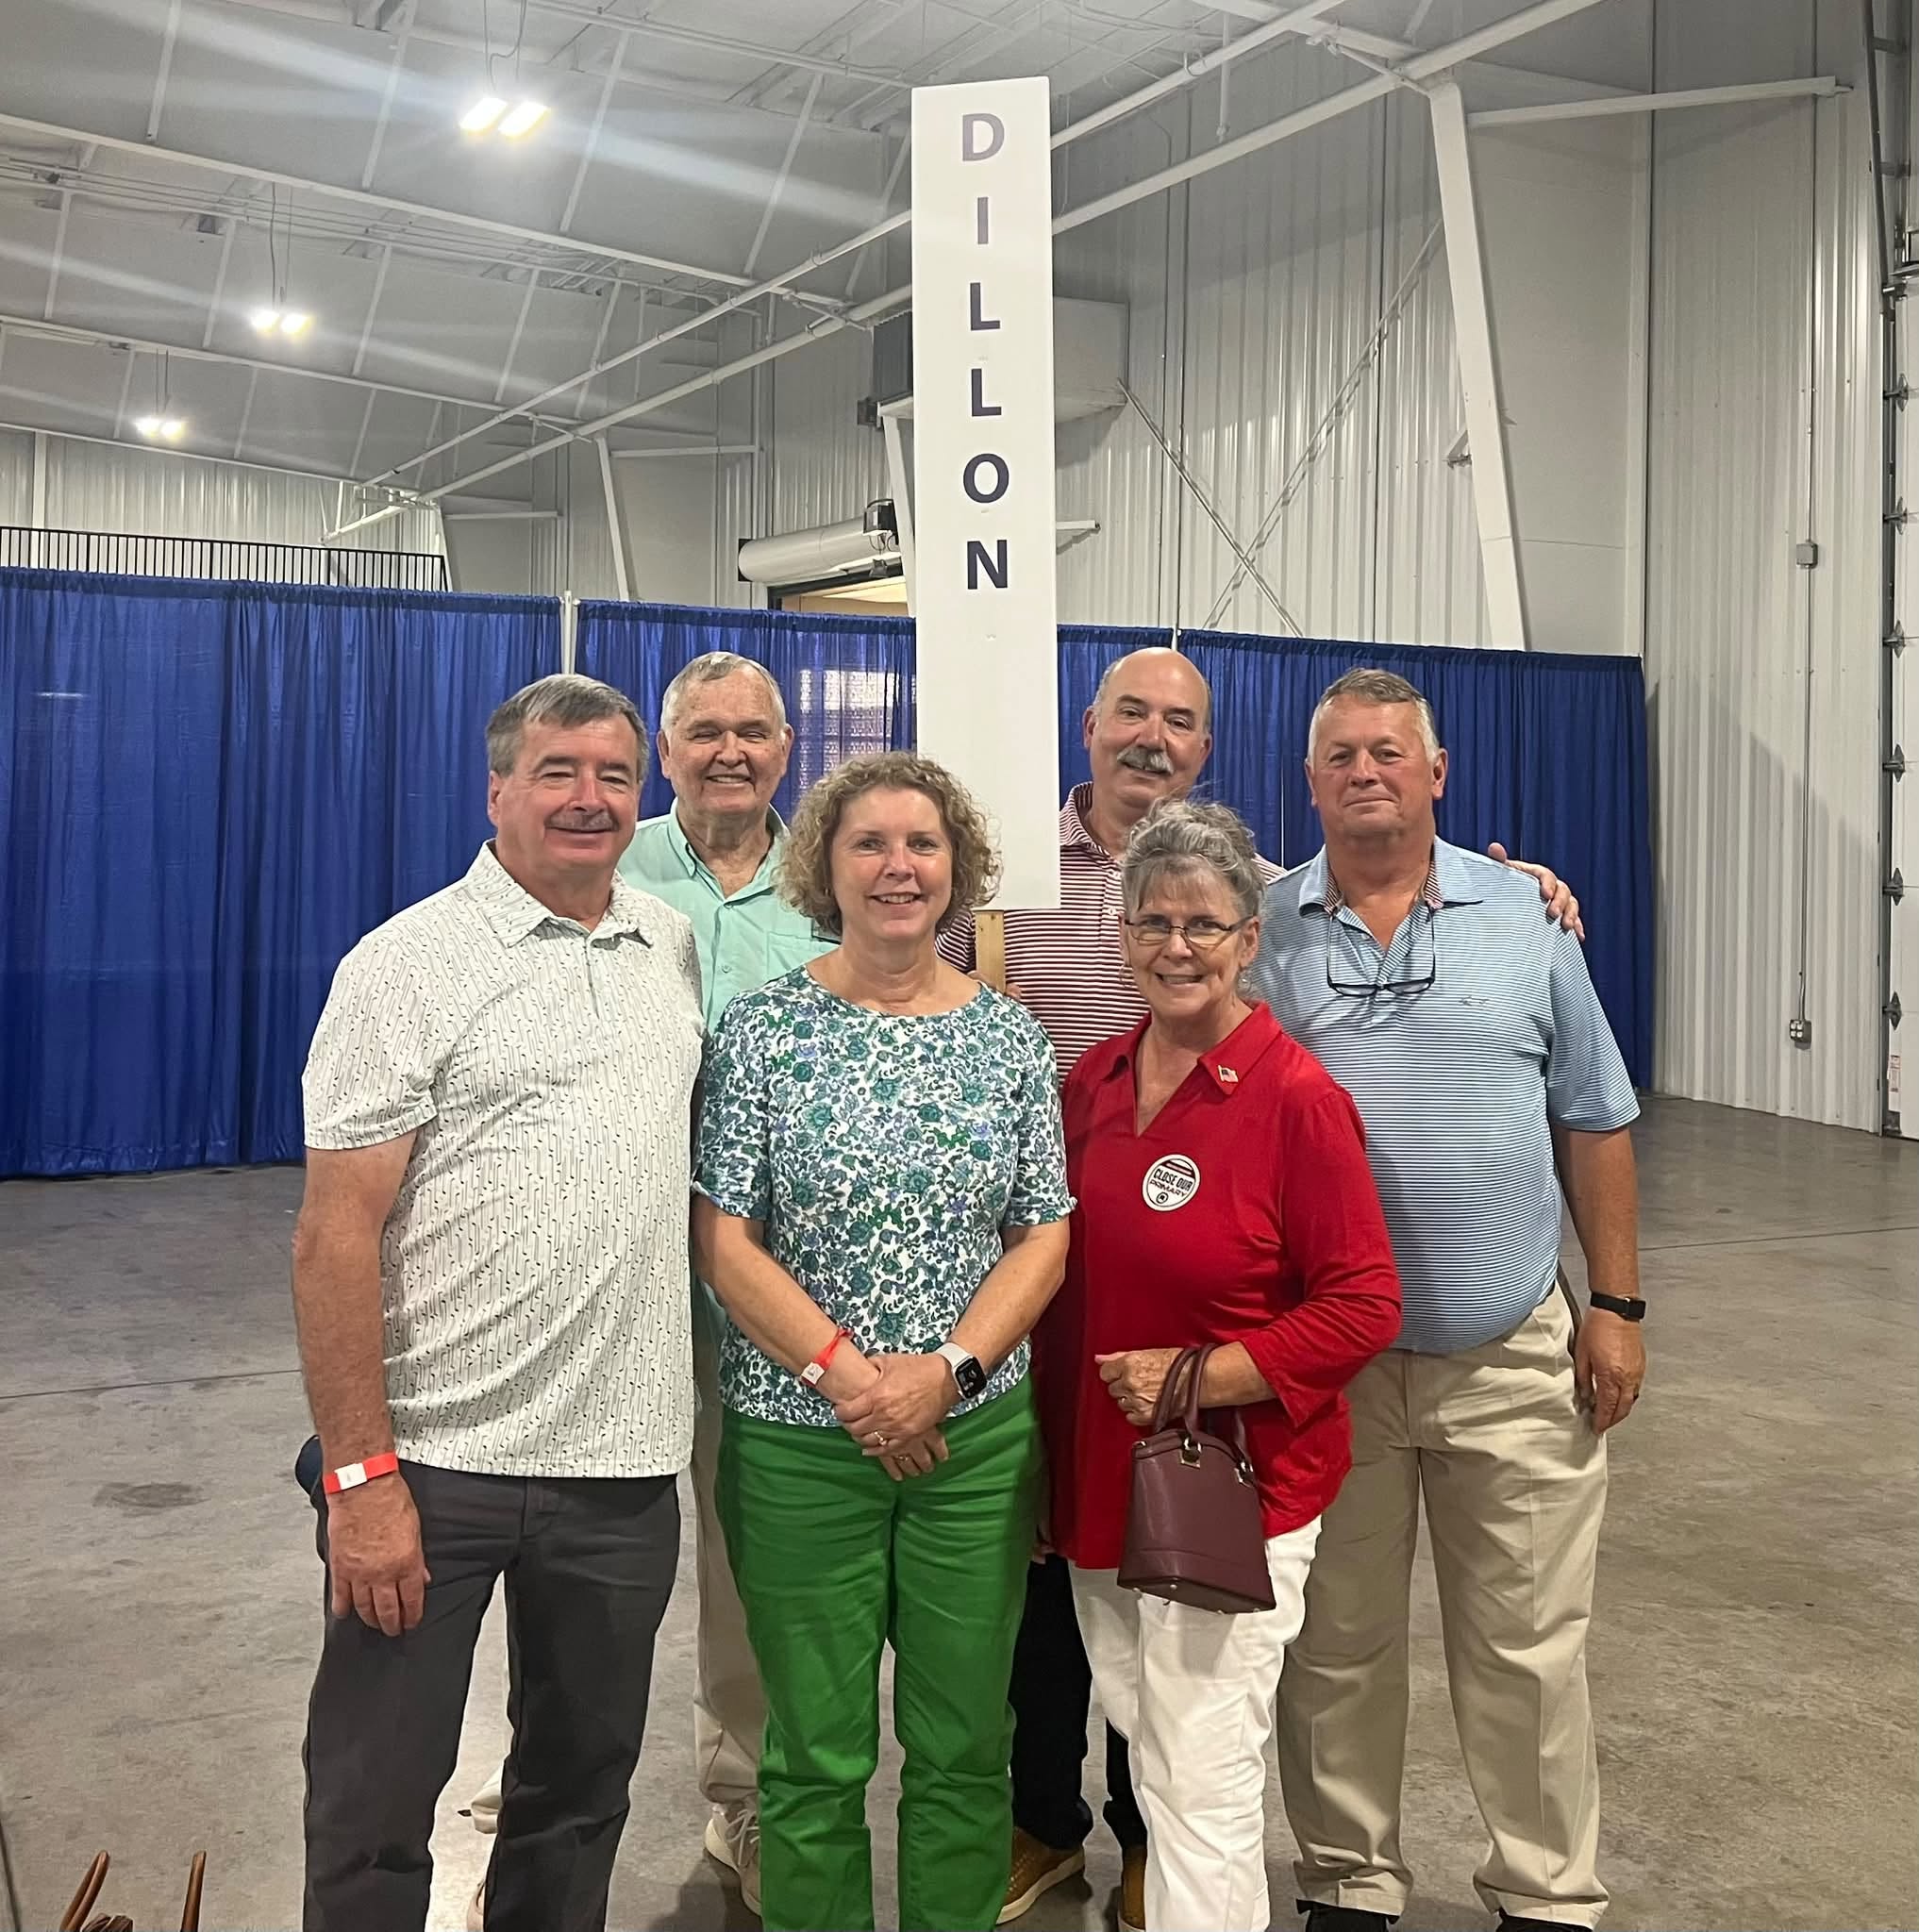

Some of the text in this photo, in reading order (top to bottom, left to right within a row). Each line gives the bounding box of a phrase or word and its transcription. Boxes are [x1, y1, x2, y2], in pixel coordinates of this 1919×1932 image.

[960, 112, 1010, 591] DILLON
[1149, 1178, 1188, 1197] PRIMARY
[1153, 1168, 1193, 1191] CLOSE OUR
